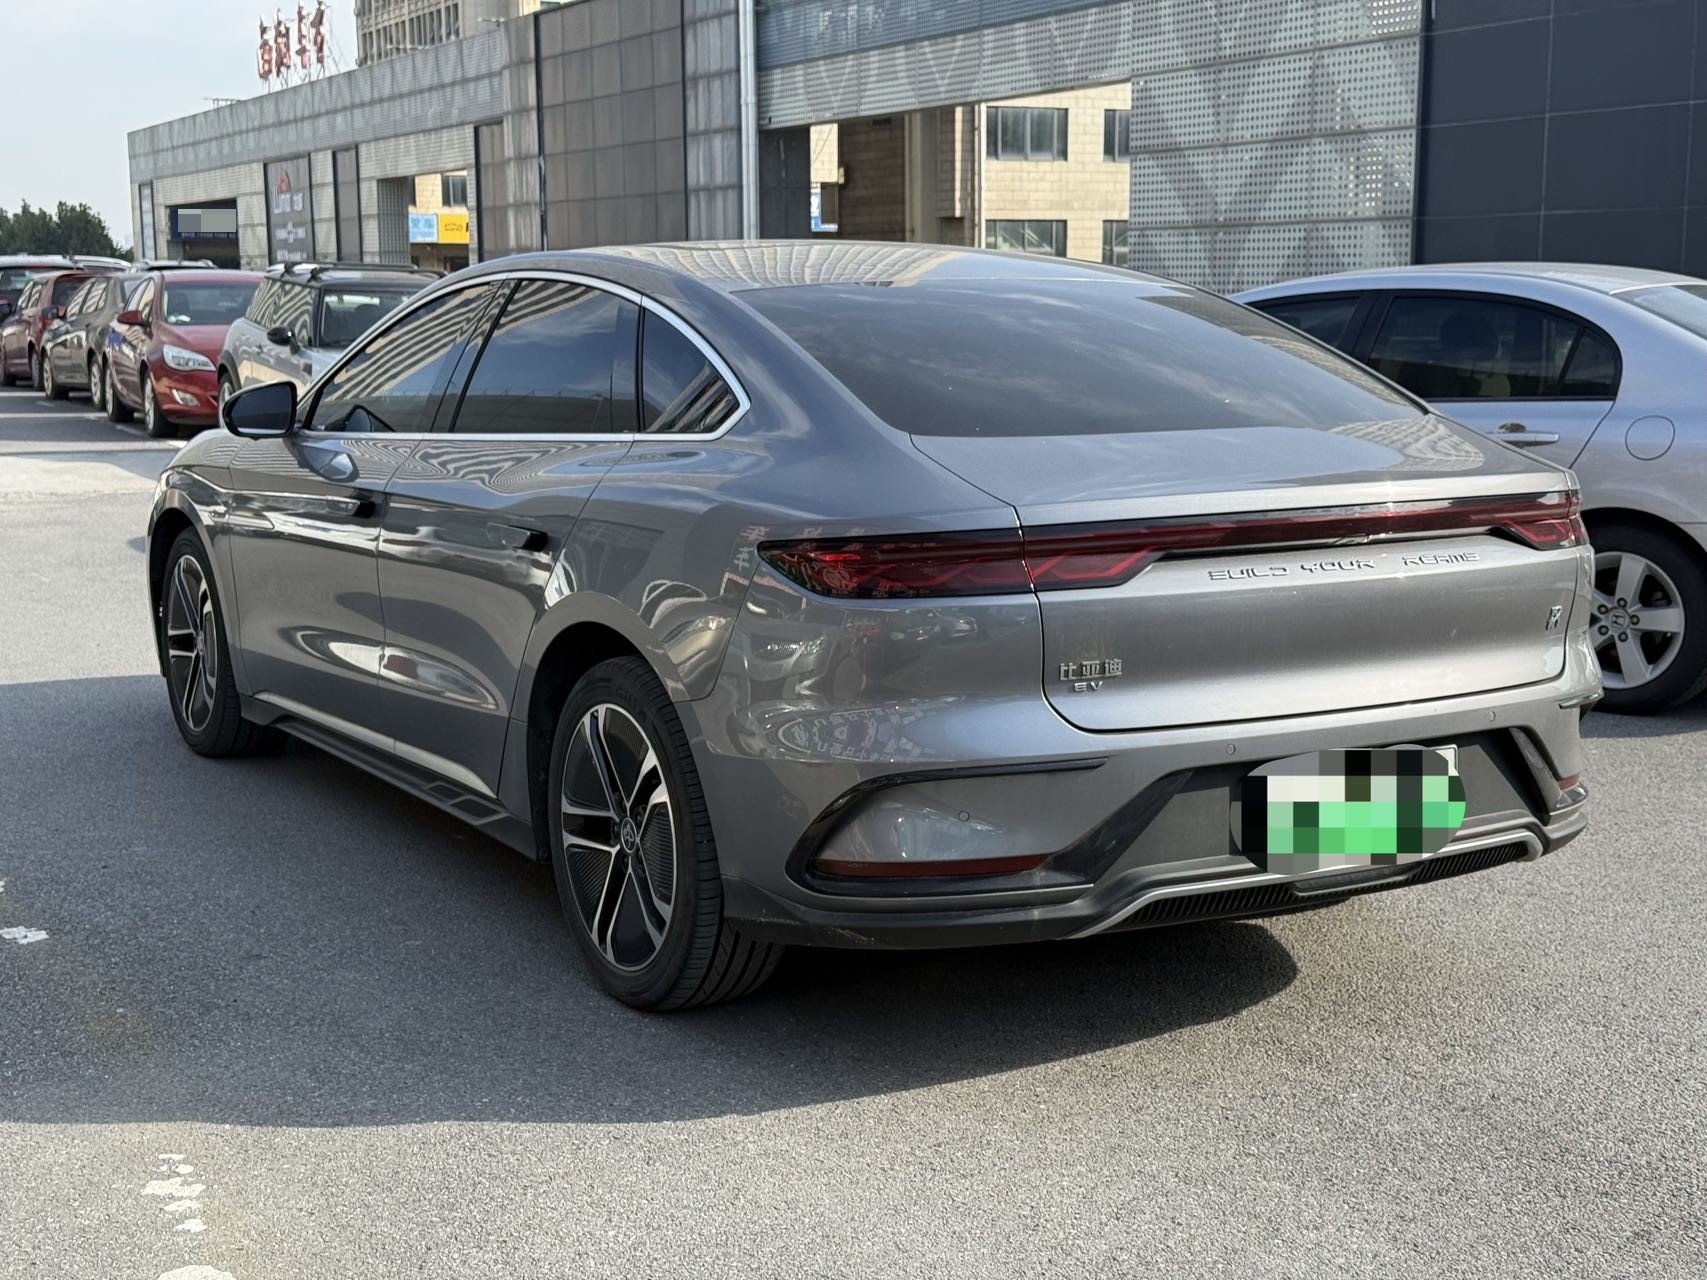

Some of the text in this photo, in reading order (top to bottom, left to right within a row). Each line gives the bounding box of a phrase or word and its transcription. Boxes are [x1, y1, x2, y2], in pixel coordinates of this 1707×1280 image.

[1207, 566, 1290, 581] BUILD
[1300, 558, 1377, 575] YOUR
[1074, 681, 1103, 692] EV
